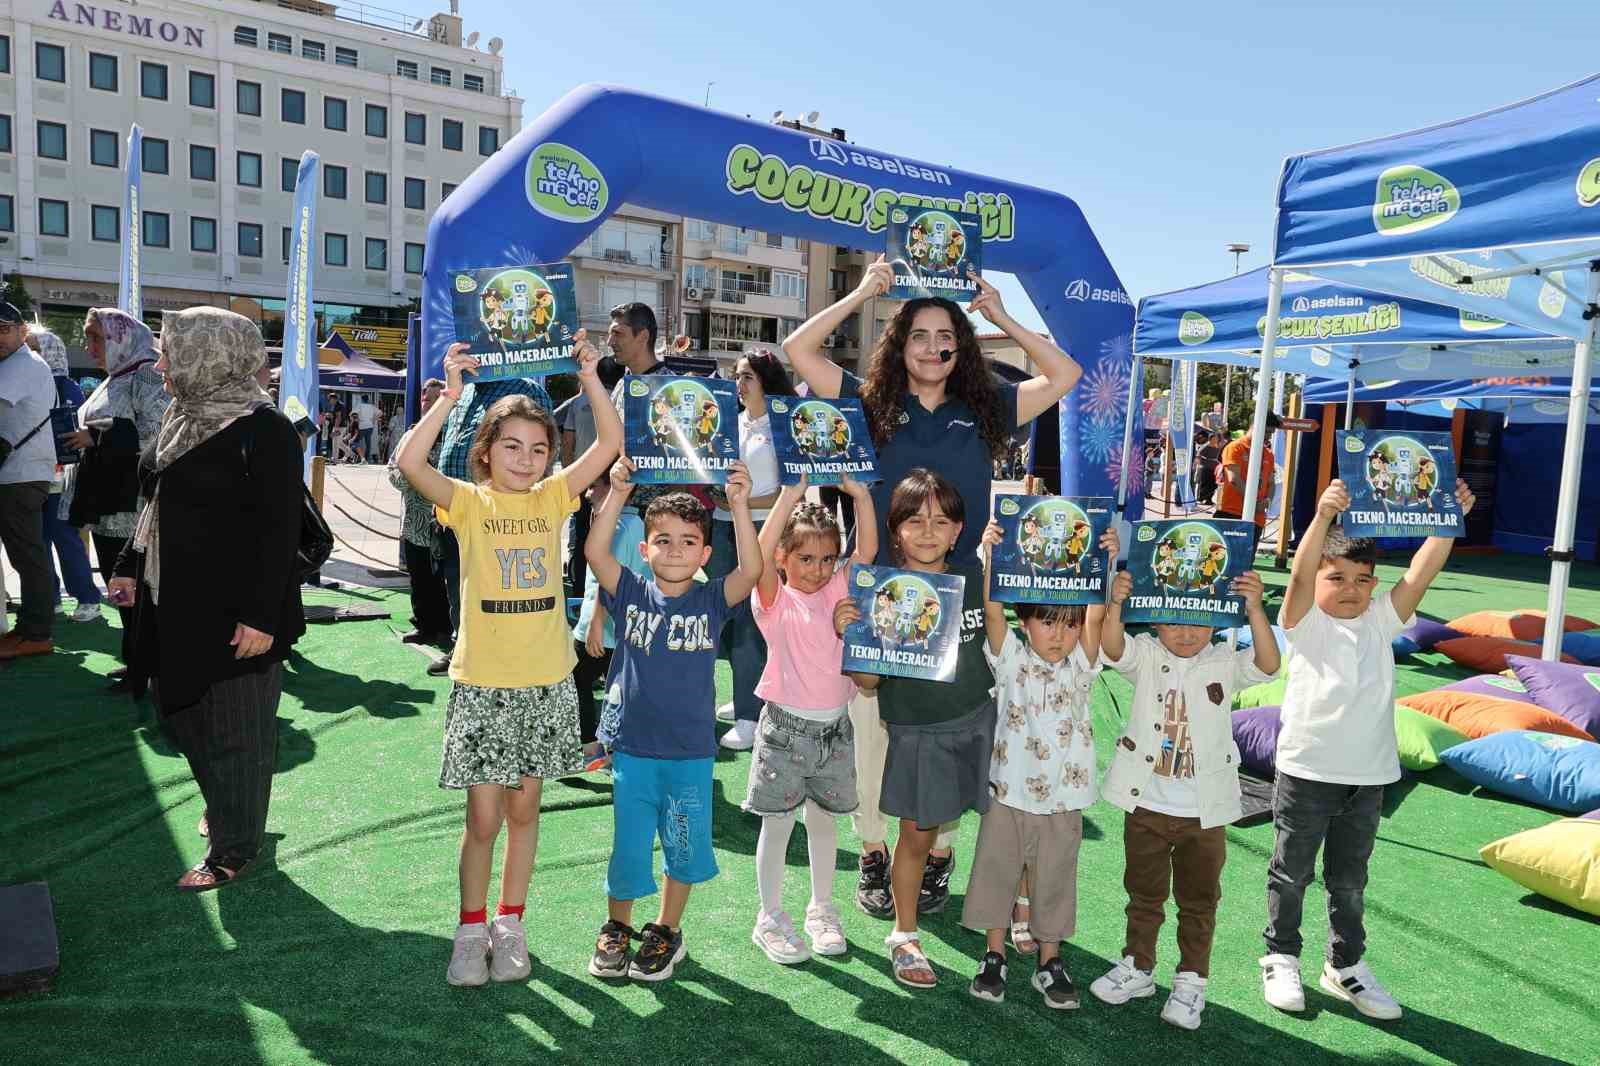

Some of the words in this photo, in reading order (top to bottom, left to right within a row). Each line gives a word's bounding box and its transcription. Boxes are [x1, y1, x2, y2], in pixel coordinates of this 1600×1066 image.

[48, 0, 205, 48] ANEMON
[545, 161, 600, 194] tekno
[851, 152, 952, 186] aselsan
[727, 145, 870, 226] ÇOCUK
[1391, 178, 1444, 202] tekno
[895, 274, 918, 287] EKNO
[1311, 294, 1363, 309] aselsan
[1318, 302, 1400, 338] ŞENLİĞİ
[631, 455, 665, 469] TEKNO
[783, 462, 813, 474] TEKNO
[813, 461, 874, 473] MACERACILAR
[483, 518, 526, 535] SWEET
[1349, 510, 1385, 524] TEKNO
[1388, 511, 1458, 526] MACERACILAR
[495, 547, 547, 590] YES
[996, 573, 1031, 588] TEKNO
[1033, 575, 1102, 591] MACERACILAR
[494, 599, 547, 613] FRIENDS
[1129, 596, 1163, 609] TEKNO
[1164, 596, 1240, 614] MACERACILAR
[849, 644, 881, 660] TEKNO
